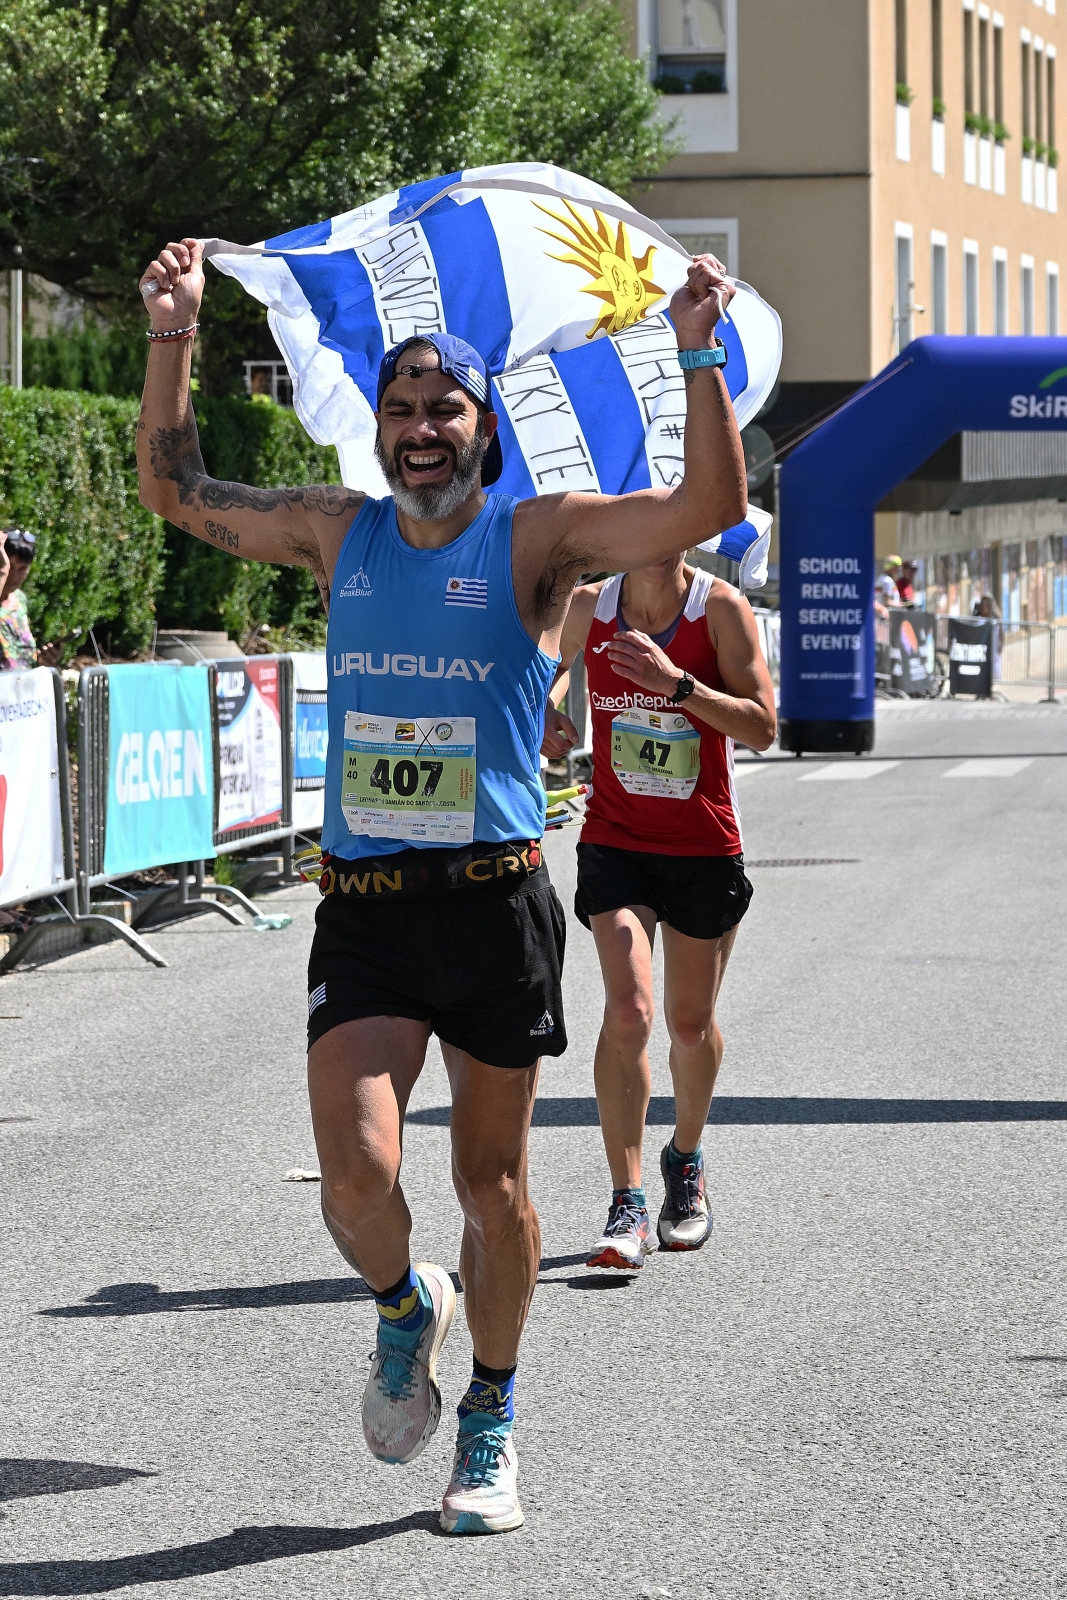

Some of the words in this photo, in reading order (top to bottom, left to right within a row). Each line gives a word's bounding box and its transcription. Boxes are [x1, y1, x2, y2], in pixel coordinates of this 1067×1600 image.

[1010, 394, 1067, 418] SkiR
[799, 557, 862, 574] SCHOOL
[339, 588, 373, 598] BeakBlue
[801, 583, 860, 599] RENTAL
[799, 608, 863, 625] SERVICE
[801, 633, 861, 650] EVENTS
[333, 652, 495, 683] URUGUAY
[613, 744, 622, 752] 45
[640, 739, 671, 768] 47
[349, 757, 357, 766] M
[347, 771, 358, 780] 40
[369, 758, 444, 798] 407
